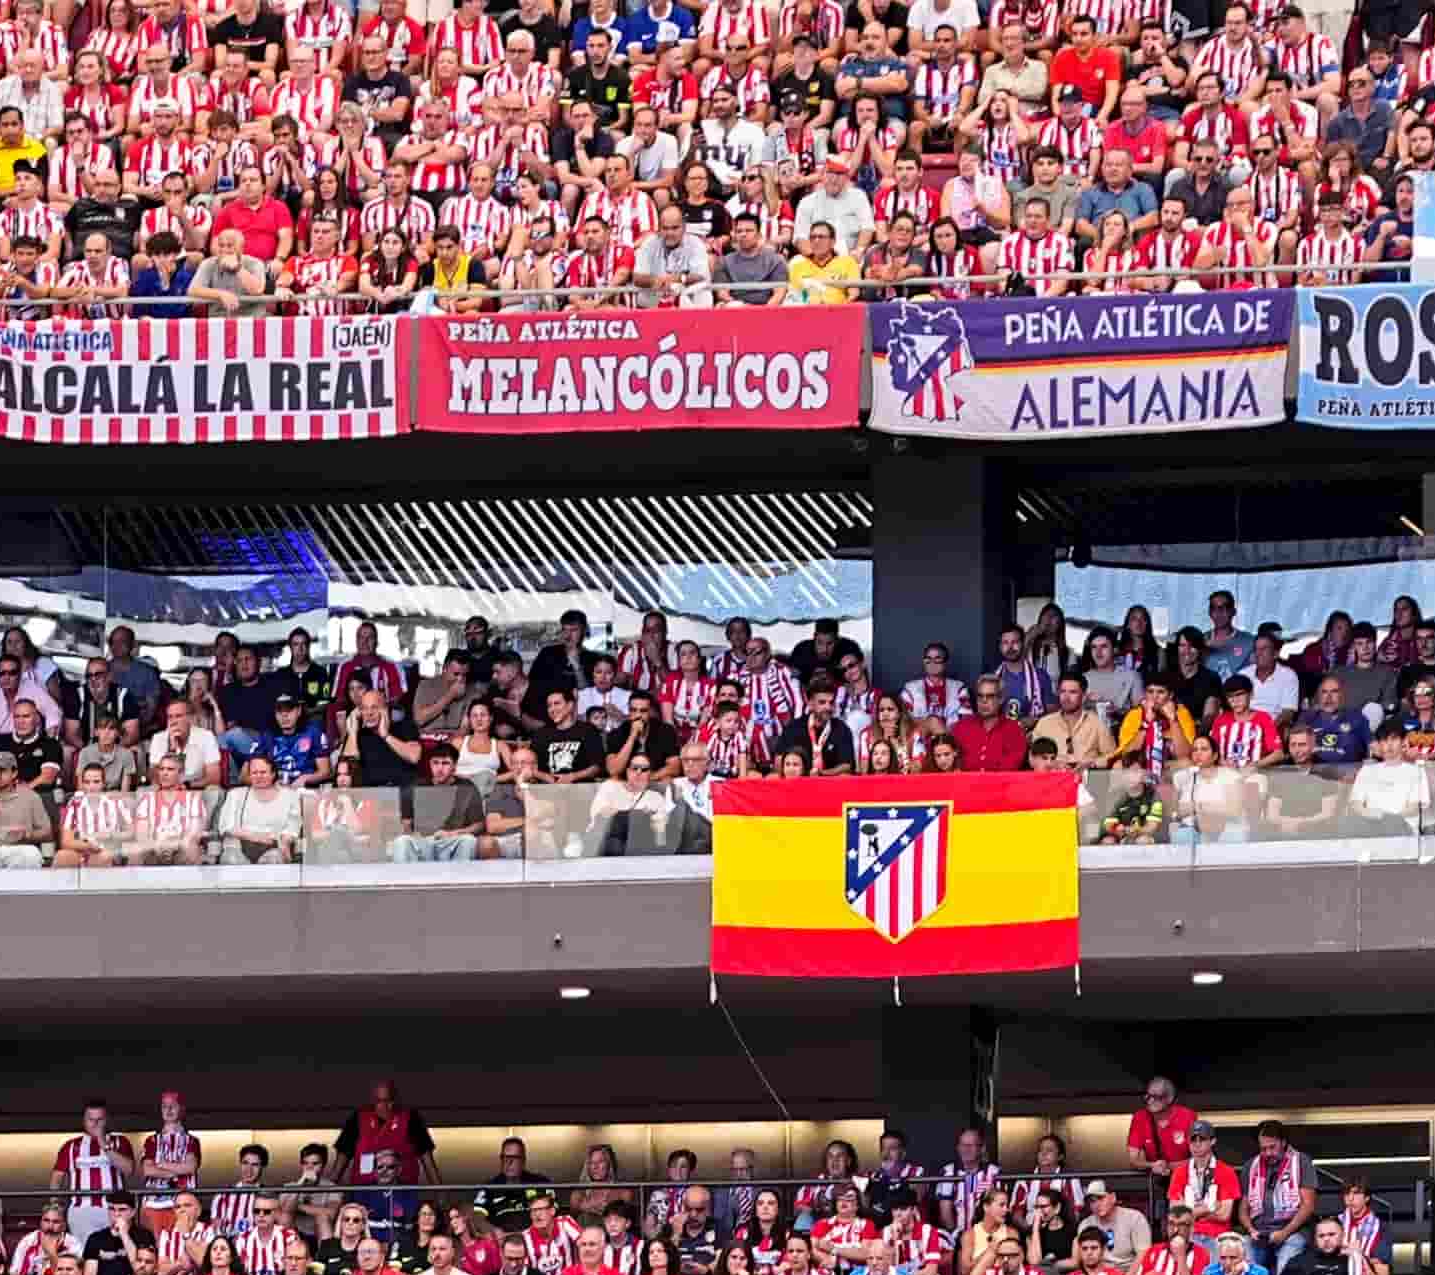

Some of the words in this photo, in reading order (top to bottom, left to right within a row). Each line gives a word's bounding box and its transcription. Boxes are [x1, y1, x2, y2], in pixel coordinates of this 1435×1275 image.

[448, 319, 511, 344] PEÑA
[518, 314, 639, 342] ATLÉTICA
[1004, 306, 1084, 345] PEÑA
[1091, 299, 1227, 341] ATLÉTICA
[1233, 300, 1272, 335] DE
[192, 357, 266, 416] LA
[269, 353, 394, 412] REAL
[448, 333, 830, 415] MELANCÓLICOS
[1010, 370, 1262, 433] ALEMANIA
[1317, 395, 1362, 419] PEÑA
